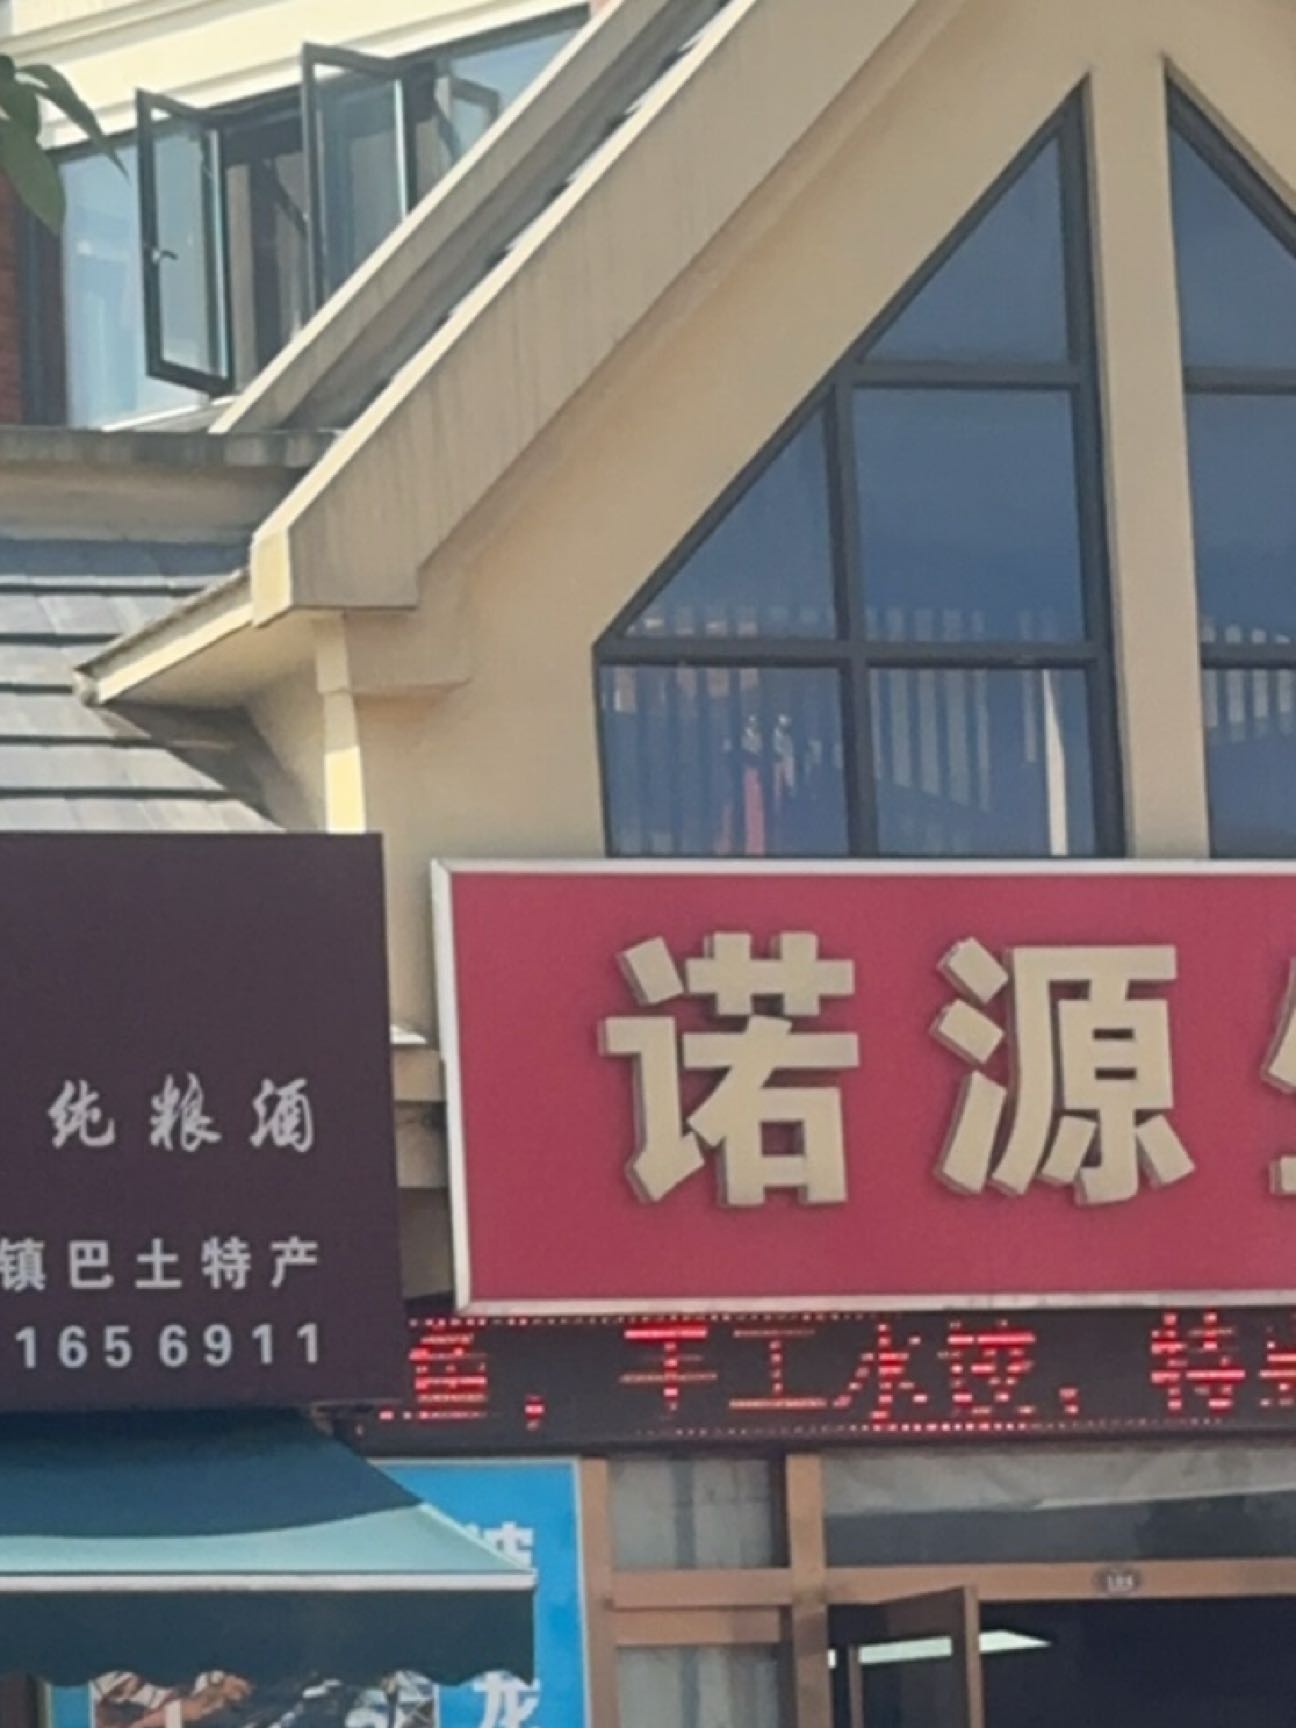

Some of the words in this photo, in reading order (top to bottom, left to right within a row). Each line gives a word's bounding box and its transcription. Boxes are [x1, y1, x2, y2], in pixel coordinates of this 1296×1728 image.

[46, 1073, 317, 1155] 纯粮酒
[597, 928, 1296, 1206] 诺源
